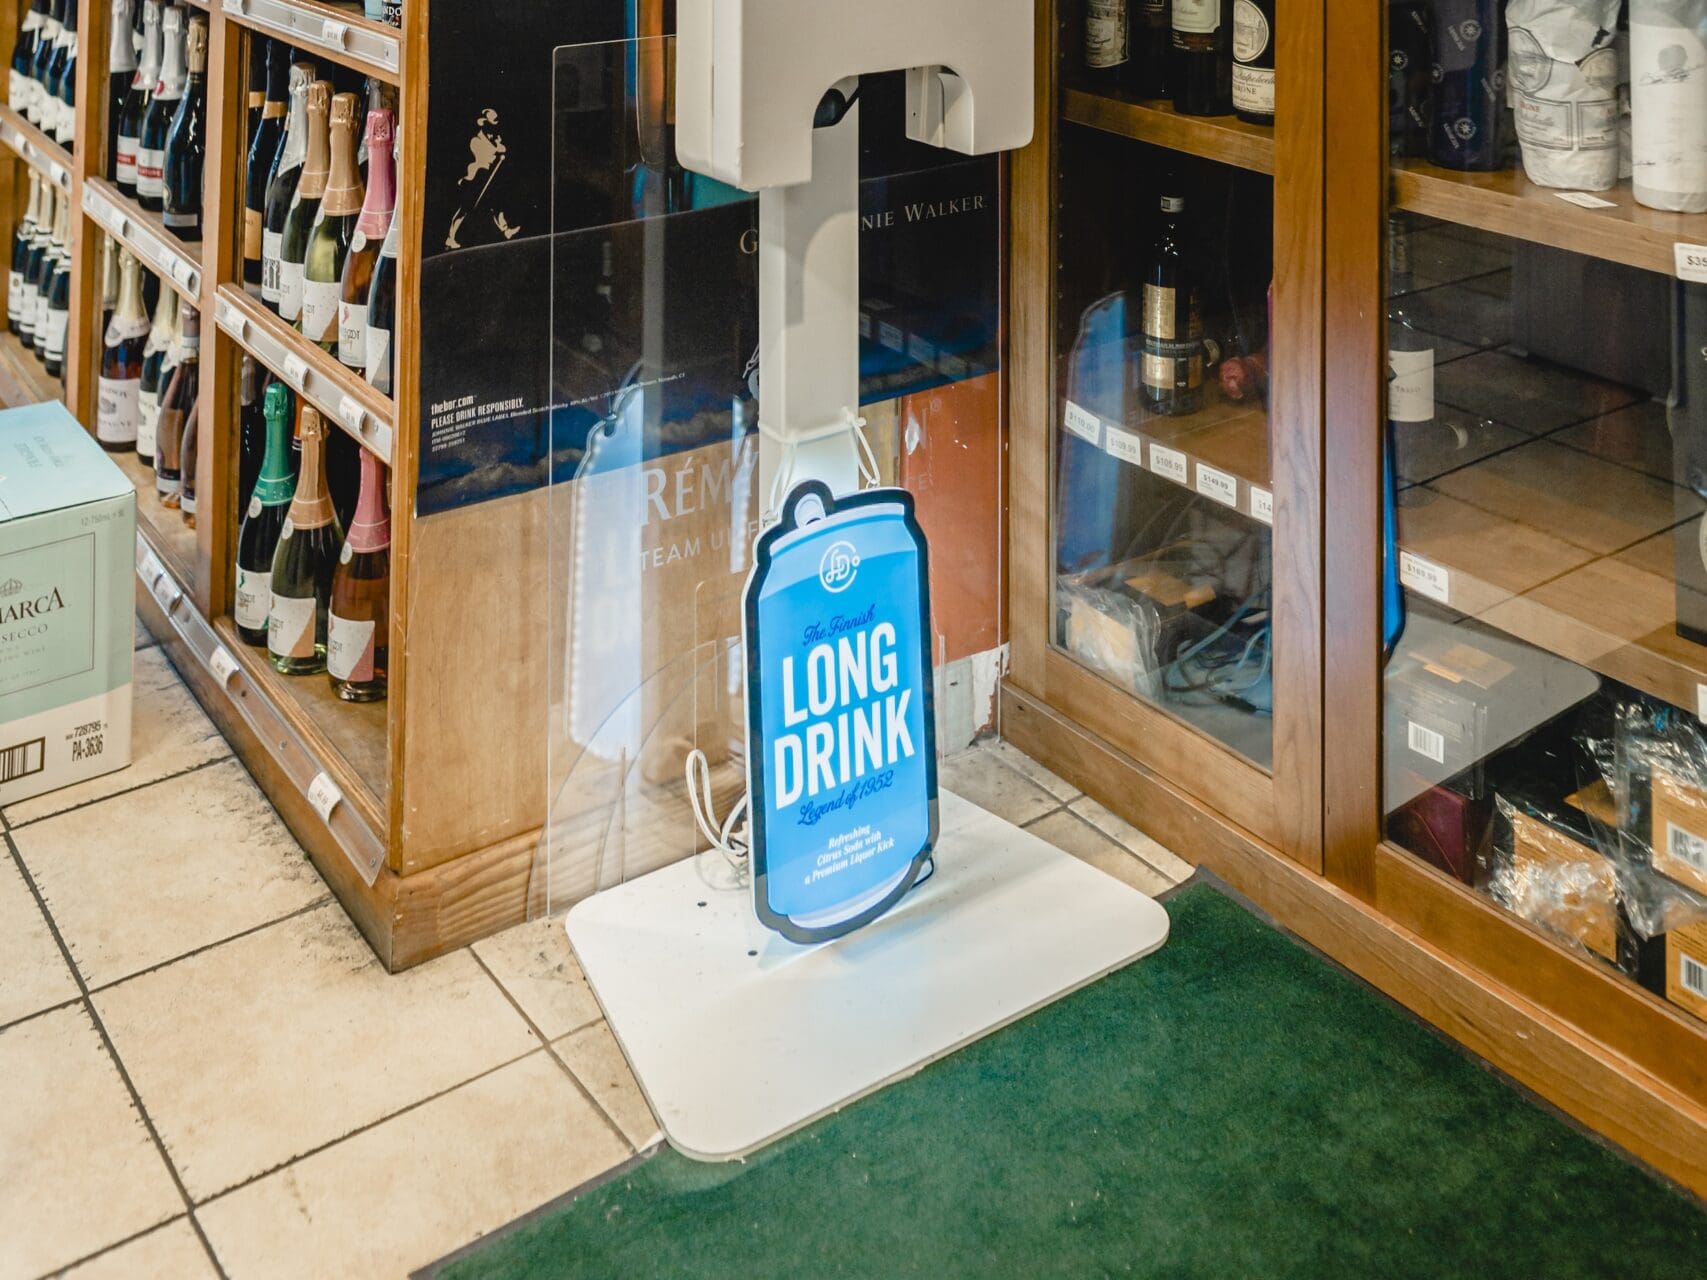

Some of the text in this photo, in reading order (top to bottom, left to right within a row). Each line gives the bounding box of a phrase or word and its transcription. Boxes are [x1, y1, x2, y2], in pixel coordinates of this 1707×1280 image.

[861, 195, 985, 233] NIE WALKER
[431, 397, 524, 429] PLEASE DRINK RESPONSIBLY.
[640, 537, 701, 572] TEAM
[802, 603, 876, 647] The Finnish
[782, 621, 899, 730] LONG
[774, 688, 916, 811] DRINK
[797, 789, 846, 826] Legend
[860, 769, 894, 800] 1952
[817, 830, 882, 867] Citrus Soda with
[828, 825, 871, 850] Refreshing
[812, 859, 849, 882] Premium
[850, 847, 876, 866] Liquor
[876, 837, 895, 854] Kick
